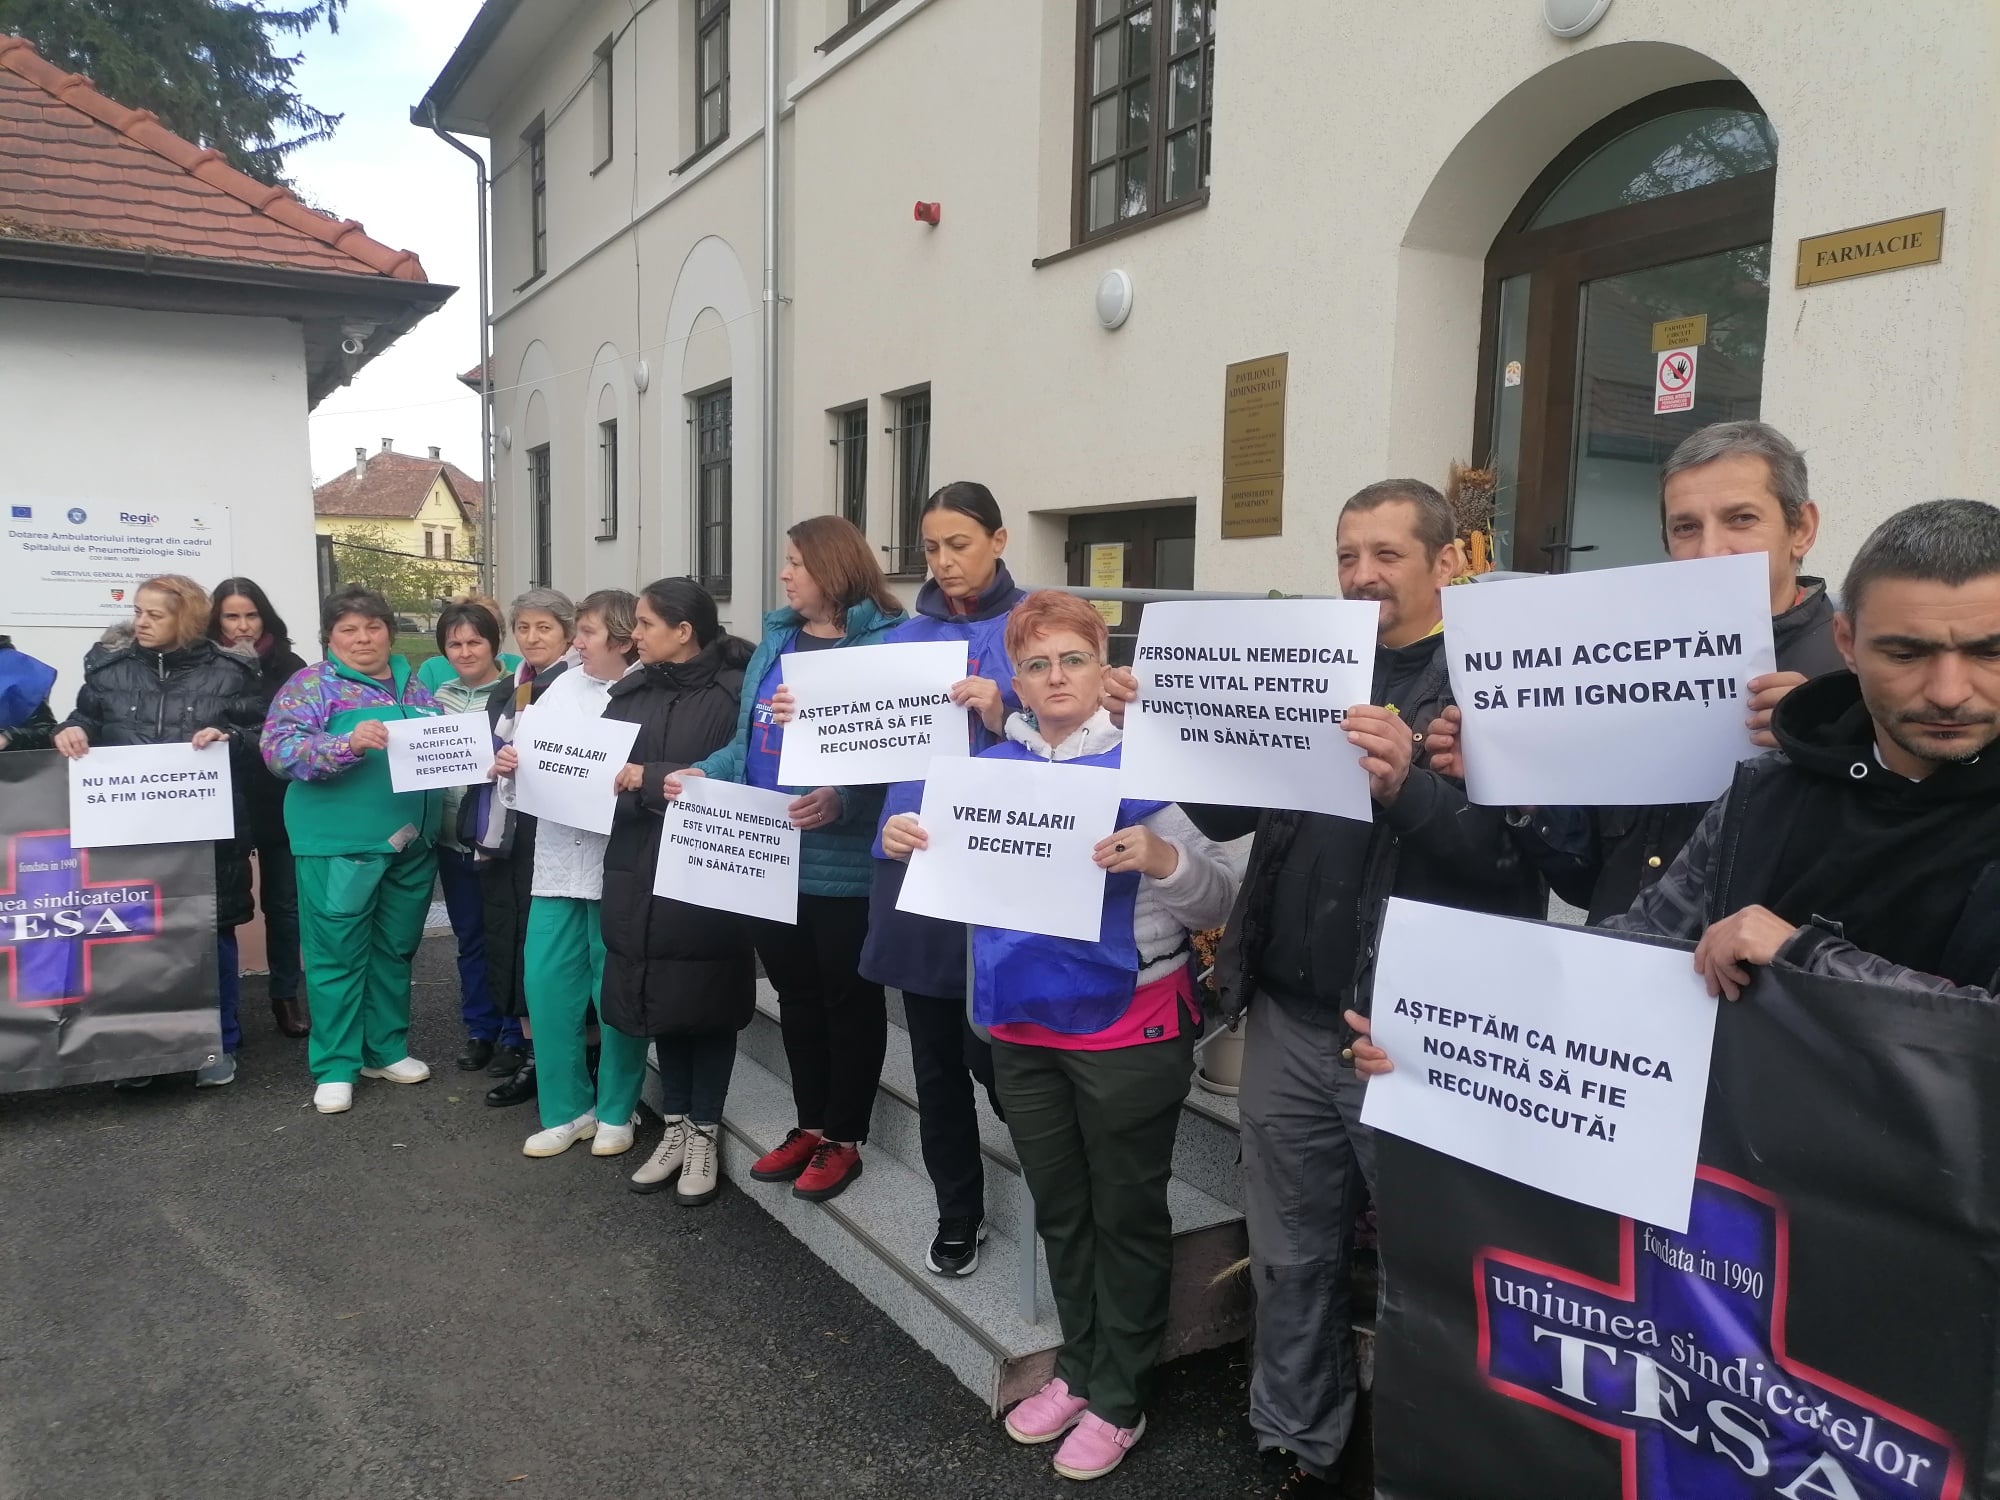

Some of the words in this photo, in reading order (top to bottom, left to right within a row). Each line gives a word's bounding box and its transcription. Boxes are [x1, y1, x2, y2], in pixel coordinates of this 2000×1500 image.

[1816, 232, 1923, 266] FARMACIE
[1235, 367, 1277, 384] PAVILIONUL
[1230, 379, 1281, 398] ADMINISTRATIV
[120, 512, 160, 524] Regio
[9, 530, 49, 540] Dotarea
[51, 532, 124, 544] Ambulatoriului
[127, 535, 163, 546] integrat
[165, 536, 181, 545] din
[183, 538, 212, 546] cadrul
[23, 542, 71, 552] Spitalului
[73, 545, 86, 553] de
[88, 545, 174, 557] Pneumoftiziologie
[177, 548, 201, 557] Sibiu
[1139, 646, 1241, 663] PERSONALUL
[1246, 647, 1359, 665] NEMEDICAL
[1464, 651, 1502, 673] NU
[1512, 646, 1562, 669] MAI
[1572, 630, 1742, 666] ACCEPTĂM
[1154, 673, 1195, 689] ESTE
[1199, 675, 1249, 691] VITAL
[1254, 677, 1329, 694] PENTRU
[1473, 685, 1509, 710] SĂ
[1517, 686, 1565, 709] FIM
[1575, 677, 1738, 708] IGNORAȚI!
[798, 699, 871, 723] AȘTEPTĂM
[875, 698, 895, 712] CA
[898, 692, 951, 709] MUNCA
[1142, 699, 1270, 720] FUNCȚIONAREA
[1274, 706, 1348, 724] ECHIPEI
[423, 725, 459, 736] MEREU
[818, 718, 884, 737] NOASTRĂ
[887, 715, 906, 730] SĂ
[910, 714, 933, 727] FIE
[409, 737, 477, 751] SACRIFICAȚI,
[820, 732, 931, 754] RECUNOSCUTĂ!
[1180, 727, 1209, 743] DIN
[1214, 729, 1311, 750] SĂNĂTATE!
[417, 749, 472, 763] NICIODATĂ
[533, 739, 563, 754] VREM
[564, 745, 607, 762] SALARII
[82, 776, 103, 787] NU
[108, 775, 135, 786] MAI
[139, 769, 219, 784] ACCEPTĂM
[416, 763, 478, 776] RESPECTAȚI
[538, 760, 590, 779] DECENTE!
[87, 792, 106, 804] SĂ
[111, 792, 136, 803] FIM
[141, 787, 216, 801] IGNORAȚI!
[672, 800, 733, 820] PERSONALUL
[735, 811, 795, 831] NEMEDICAL
[952, 805, 1002, 824] VREM
[1006, 810, 1075, 830] SALARII
[682, 819, 703, 832] ESTE
[705, 824, 735, 838] VITAL
[738, 830, 781, 846] PENTRU
[670, 834, 745, 857] FUNCȚIONAREA
[748, 849, 790, 866] ECHIPEI
[967, 835, 1052, 858] DECENTE!
[19, 861, 49, 873] fondata
[50, 860, 59, 871] in
[60, 858, 77, 870] 1990
[688, 855, 703, 867] DIN
[706, 858, 766, 879] SĂNĂTATE!
[33, 887, 149, 909] sindicatelor
[0, 907, 132, 941] ESA
[1394, 997, 1519, 1044] AȘTEPTĂM
[1526, 1029, 1557, 1055] CA
[1565, 1039, 1674, 1083] MUNCA
[1423, 1035, 1531, 1083] NOASTRĂ
[1538, 1069, 1572, 1095] SĂ
[1581, 1080, 1627, 1109] FIE
[1428, 1068, 1617, 1143] RECUNOSCUTĂ!
[1643, 1227, 1694, 1273] fondata
[1700, 1250, 1717, 1281] in
[1722, 1259, 1764, 1300] 1990
[1491, 1275, 1662, 1349] uniunea
[1671, 1332, 1931, 1488] sindicatelor
[1533, 1324, 1863, 1500] TESA
